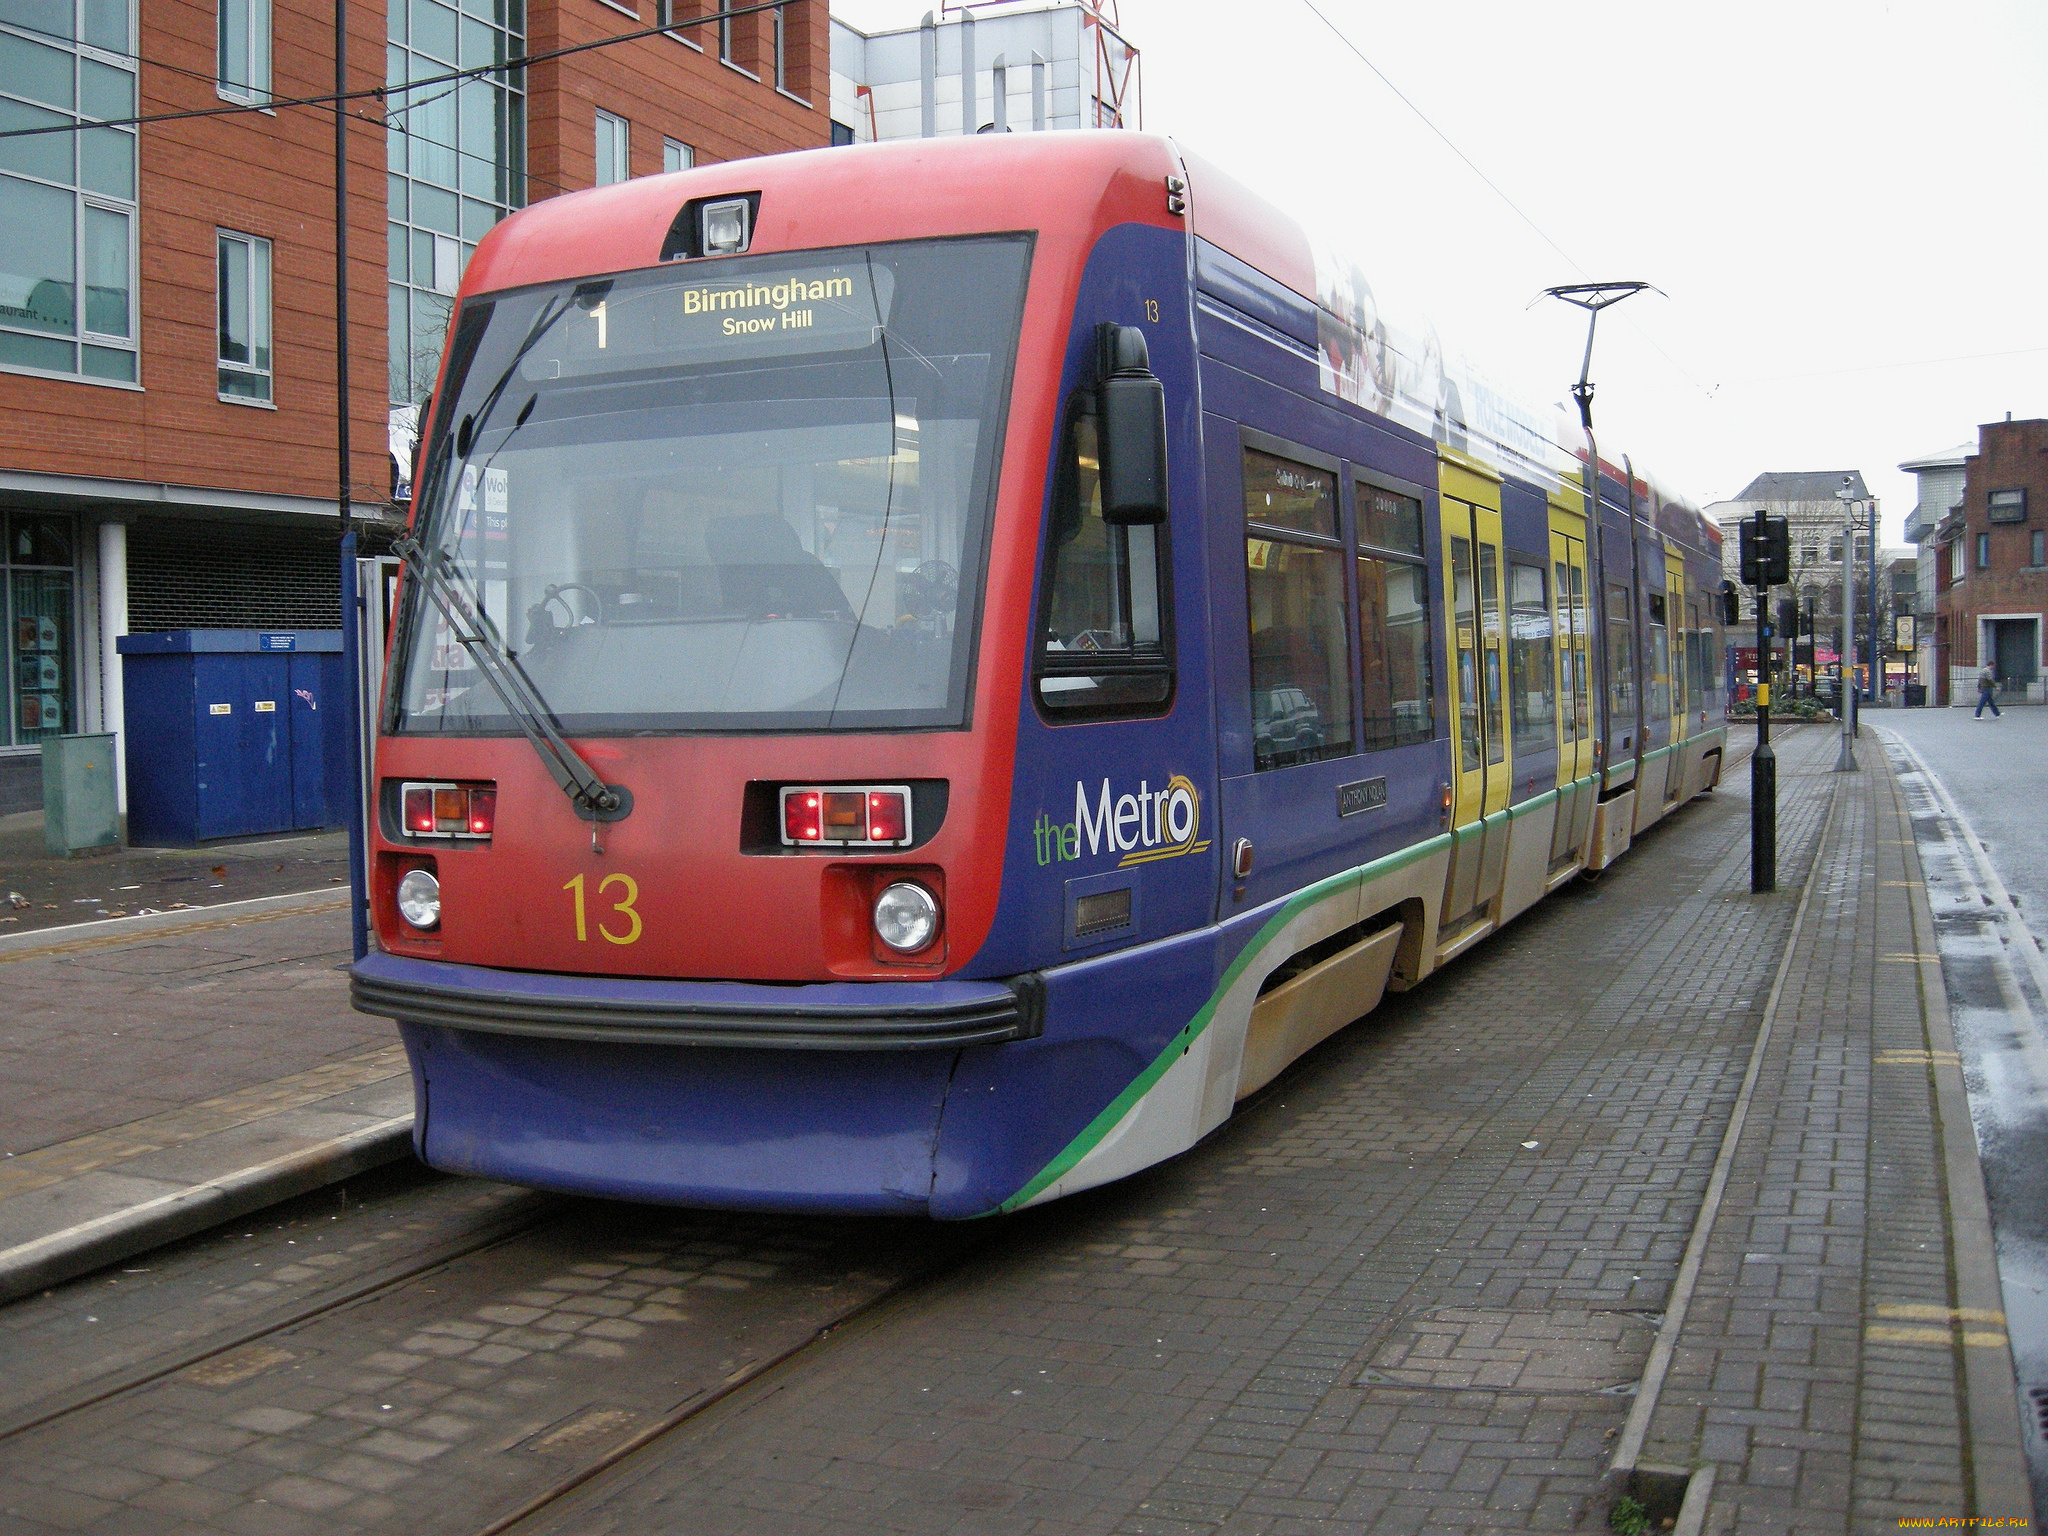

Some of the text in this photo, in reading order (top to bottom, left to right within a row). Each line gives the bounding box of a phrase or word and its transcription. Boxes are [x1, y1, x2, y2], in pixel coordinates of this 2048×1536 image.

[684, 277, 852, 314] Birmingham
[1144, 299, 1159, 323] 13
[589, 301, 606, 348] 1
[722, 309, 812, 336] Snow Hill
[1033, 778, 1194, 866] the Metro
[562, 872, 643, 945] 13
